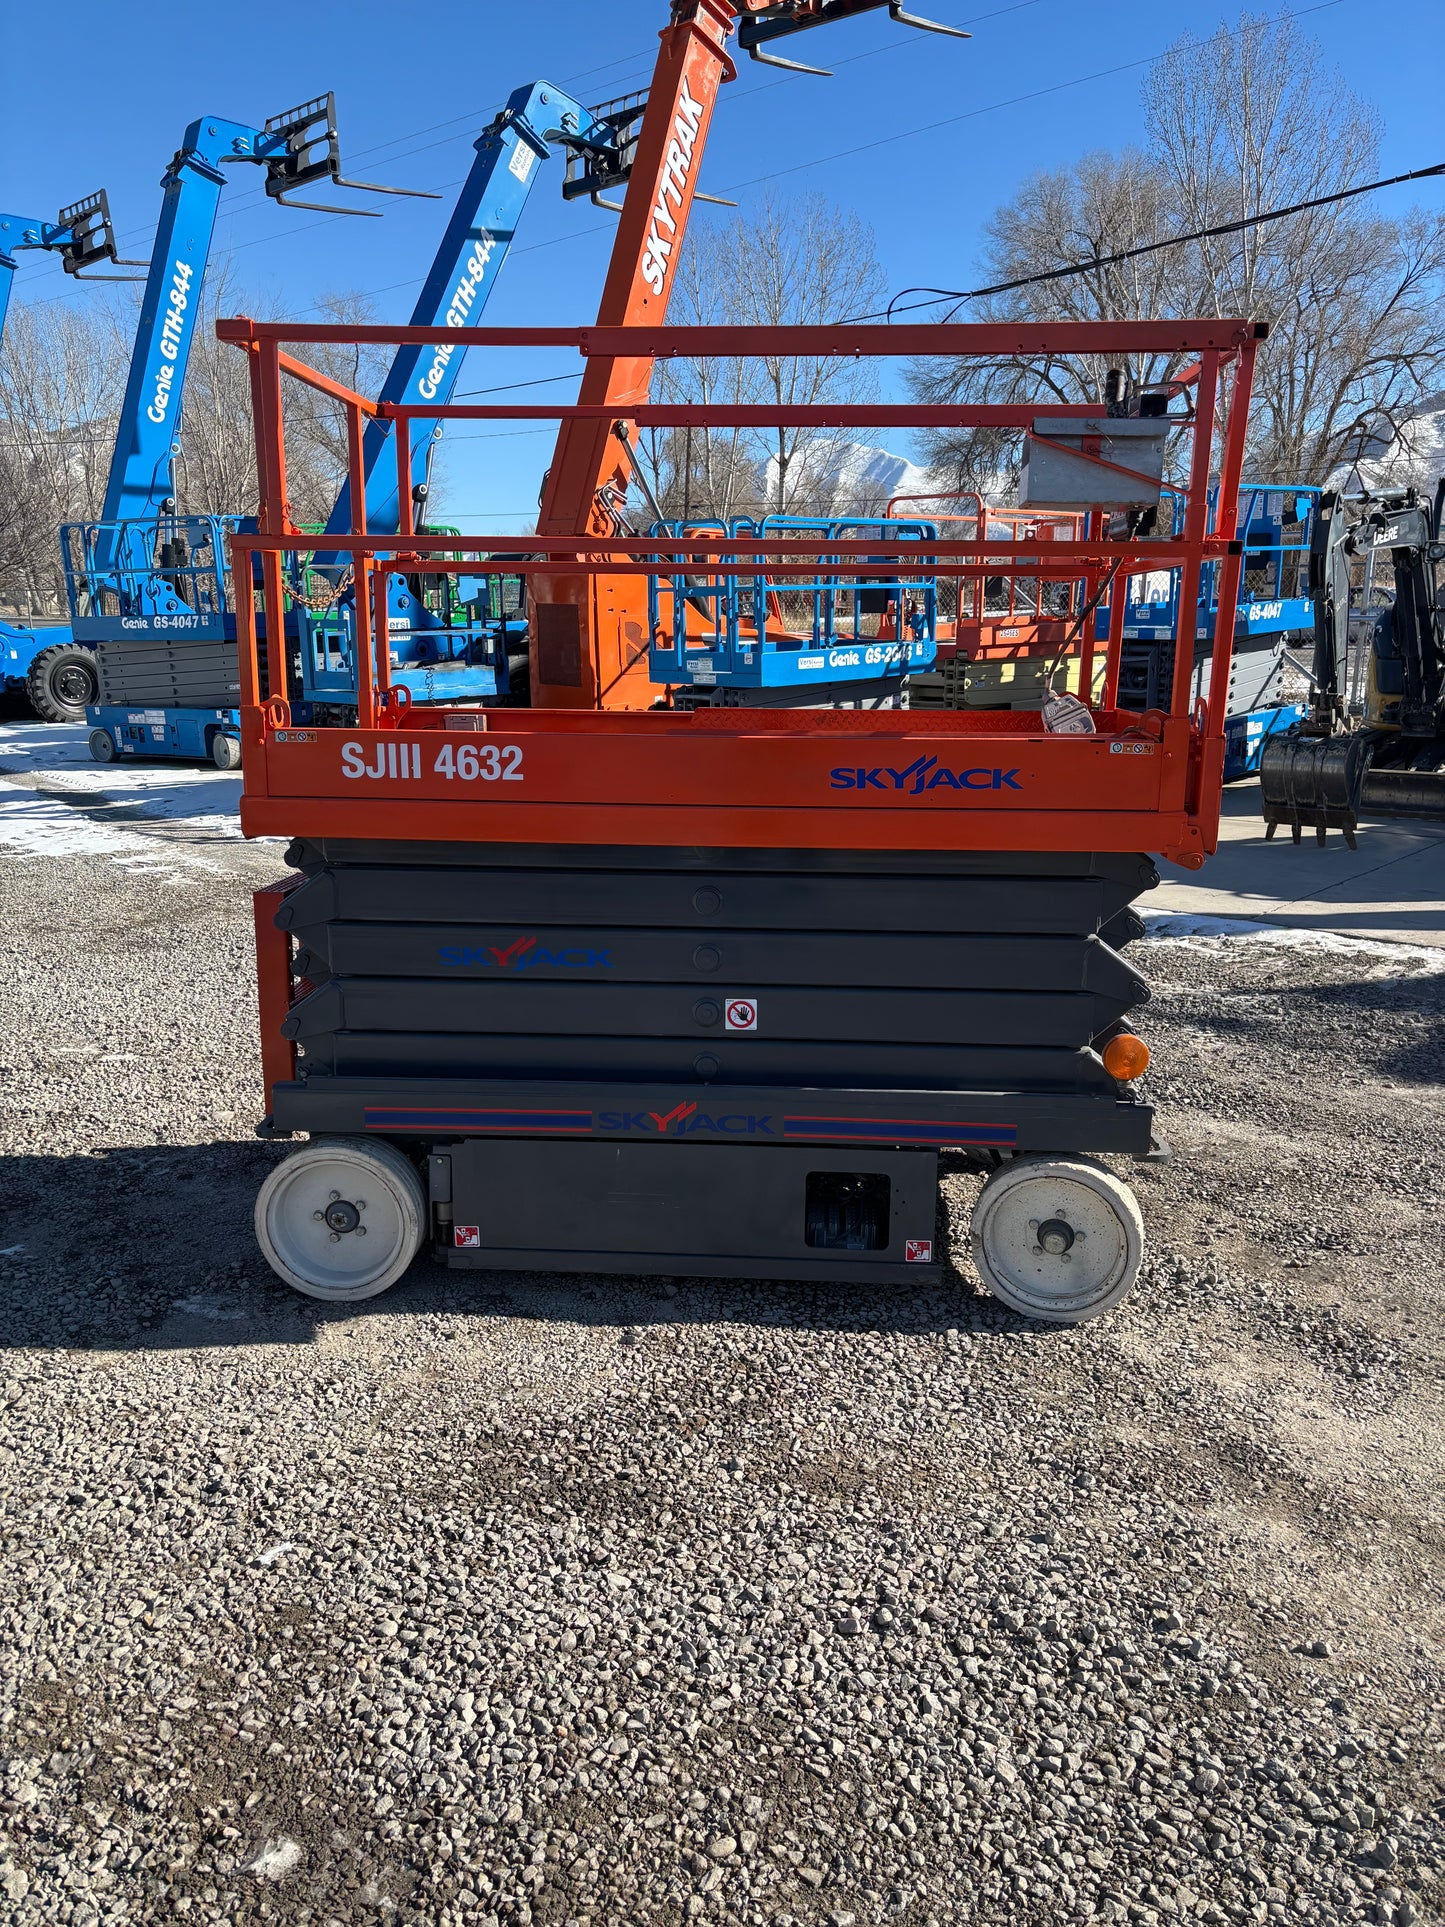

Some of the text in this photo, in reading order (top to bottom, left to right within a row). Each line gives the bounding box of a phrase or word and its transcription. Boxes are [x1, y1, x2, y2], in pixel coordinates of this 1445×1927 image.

[641, 75, 704, 296] SKYTRAK
[446, 226, 497, 328] GTH-844
[147, 259, 194, 423] Genie GTH-844
[121, 615, 199, 629] Genie GS-4047
[388, 619, 409, 629] ersi
[1249, 602, 1283, 621] GS-4047
[828, 650, 860, 668] Genie
[341, 741, 525, 781] SJIII 4632
[829, 754, 1025, 795] SKYJACK
[438, 935, 616, 972] SKYJACK
[598, 1101, 776, 1137] SKYJACK
